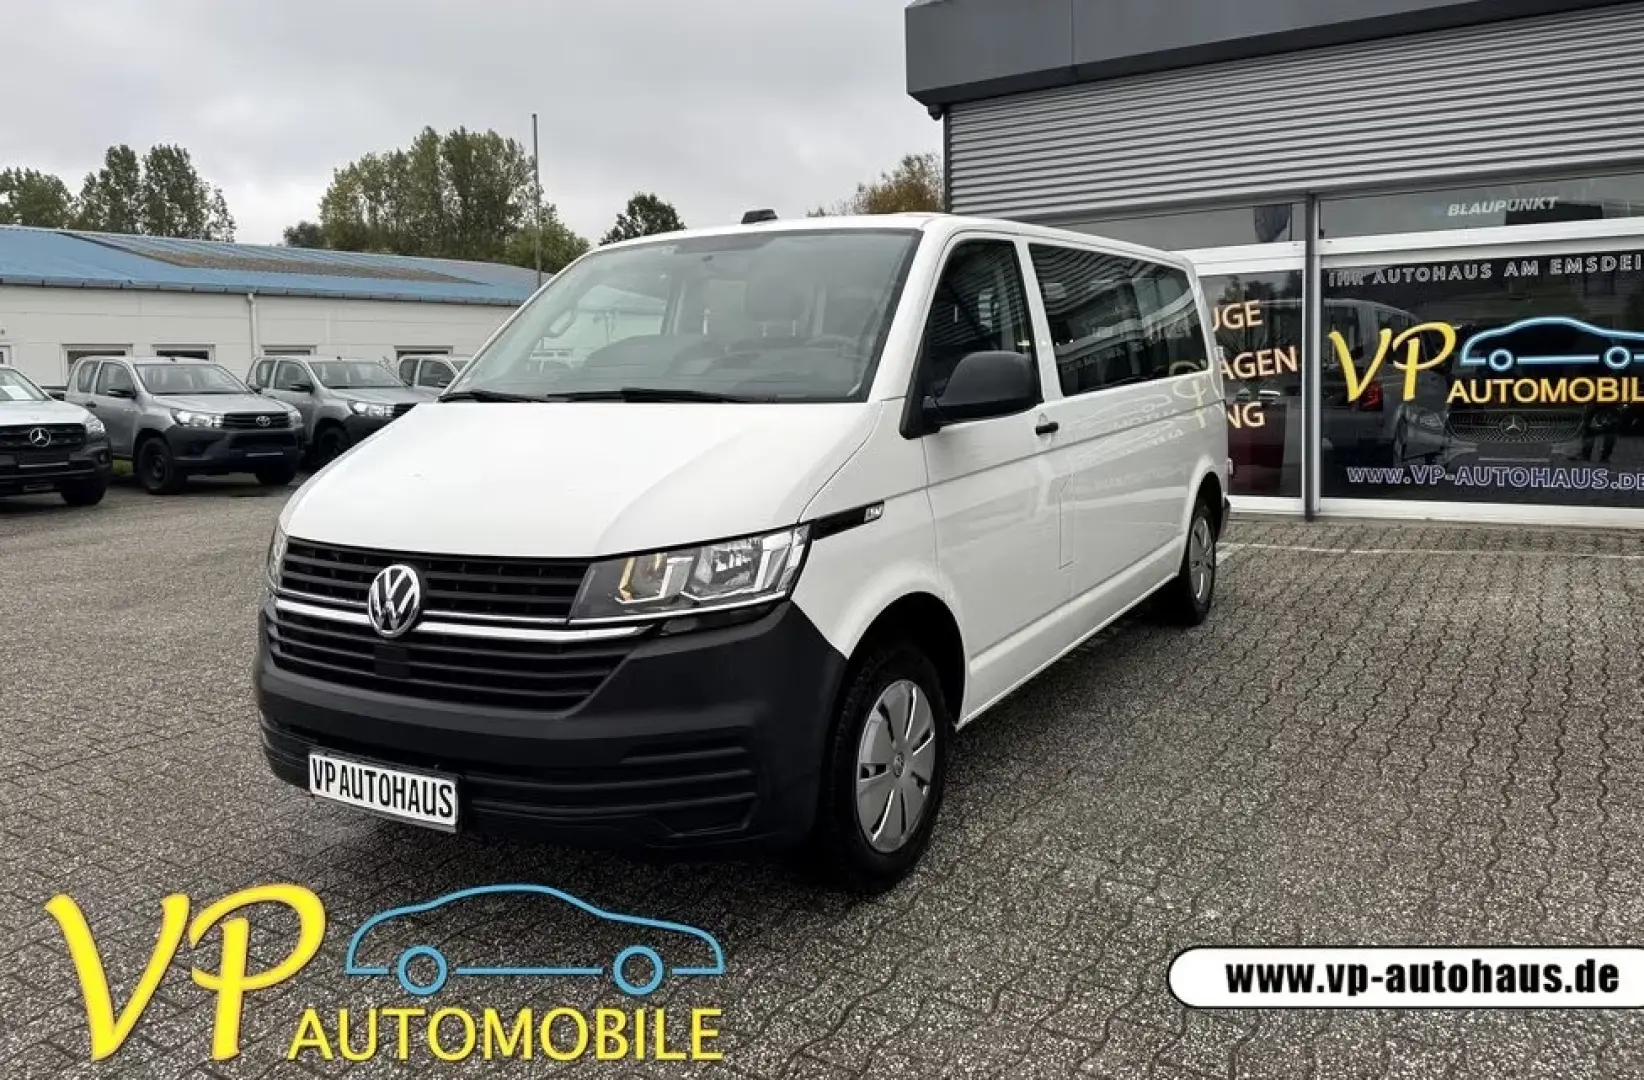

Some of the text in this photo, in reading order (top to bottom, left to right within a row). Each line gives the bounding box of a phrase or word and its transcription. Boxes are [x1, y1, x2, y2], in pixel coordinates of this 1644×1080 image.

[1447, 196, 1559, 217] BLAUPUNKT
[1328, 270, 1364, 287] IHR
[1372, 262, 1492, 285] AUTOHAUS
[1504, 258, 1539, 277] AM
[1329, 322, 1457, 401] VP
[312, 757, 453, 818] VP AUTOHAUS
